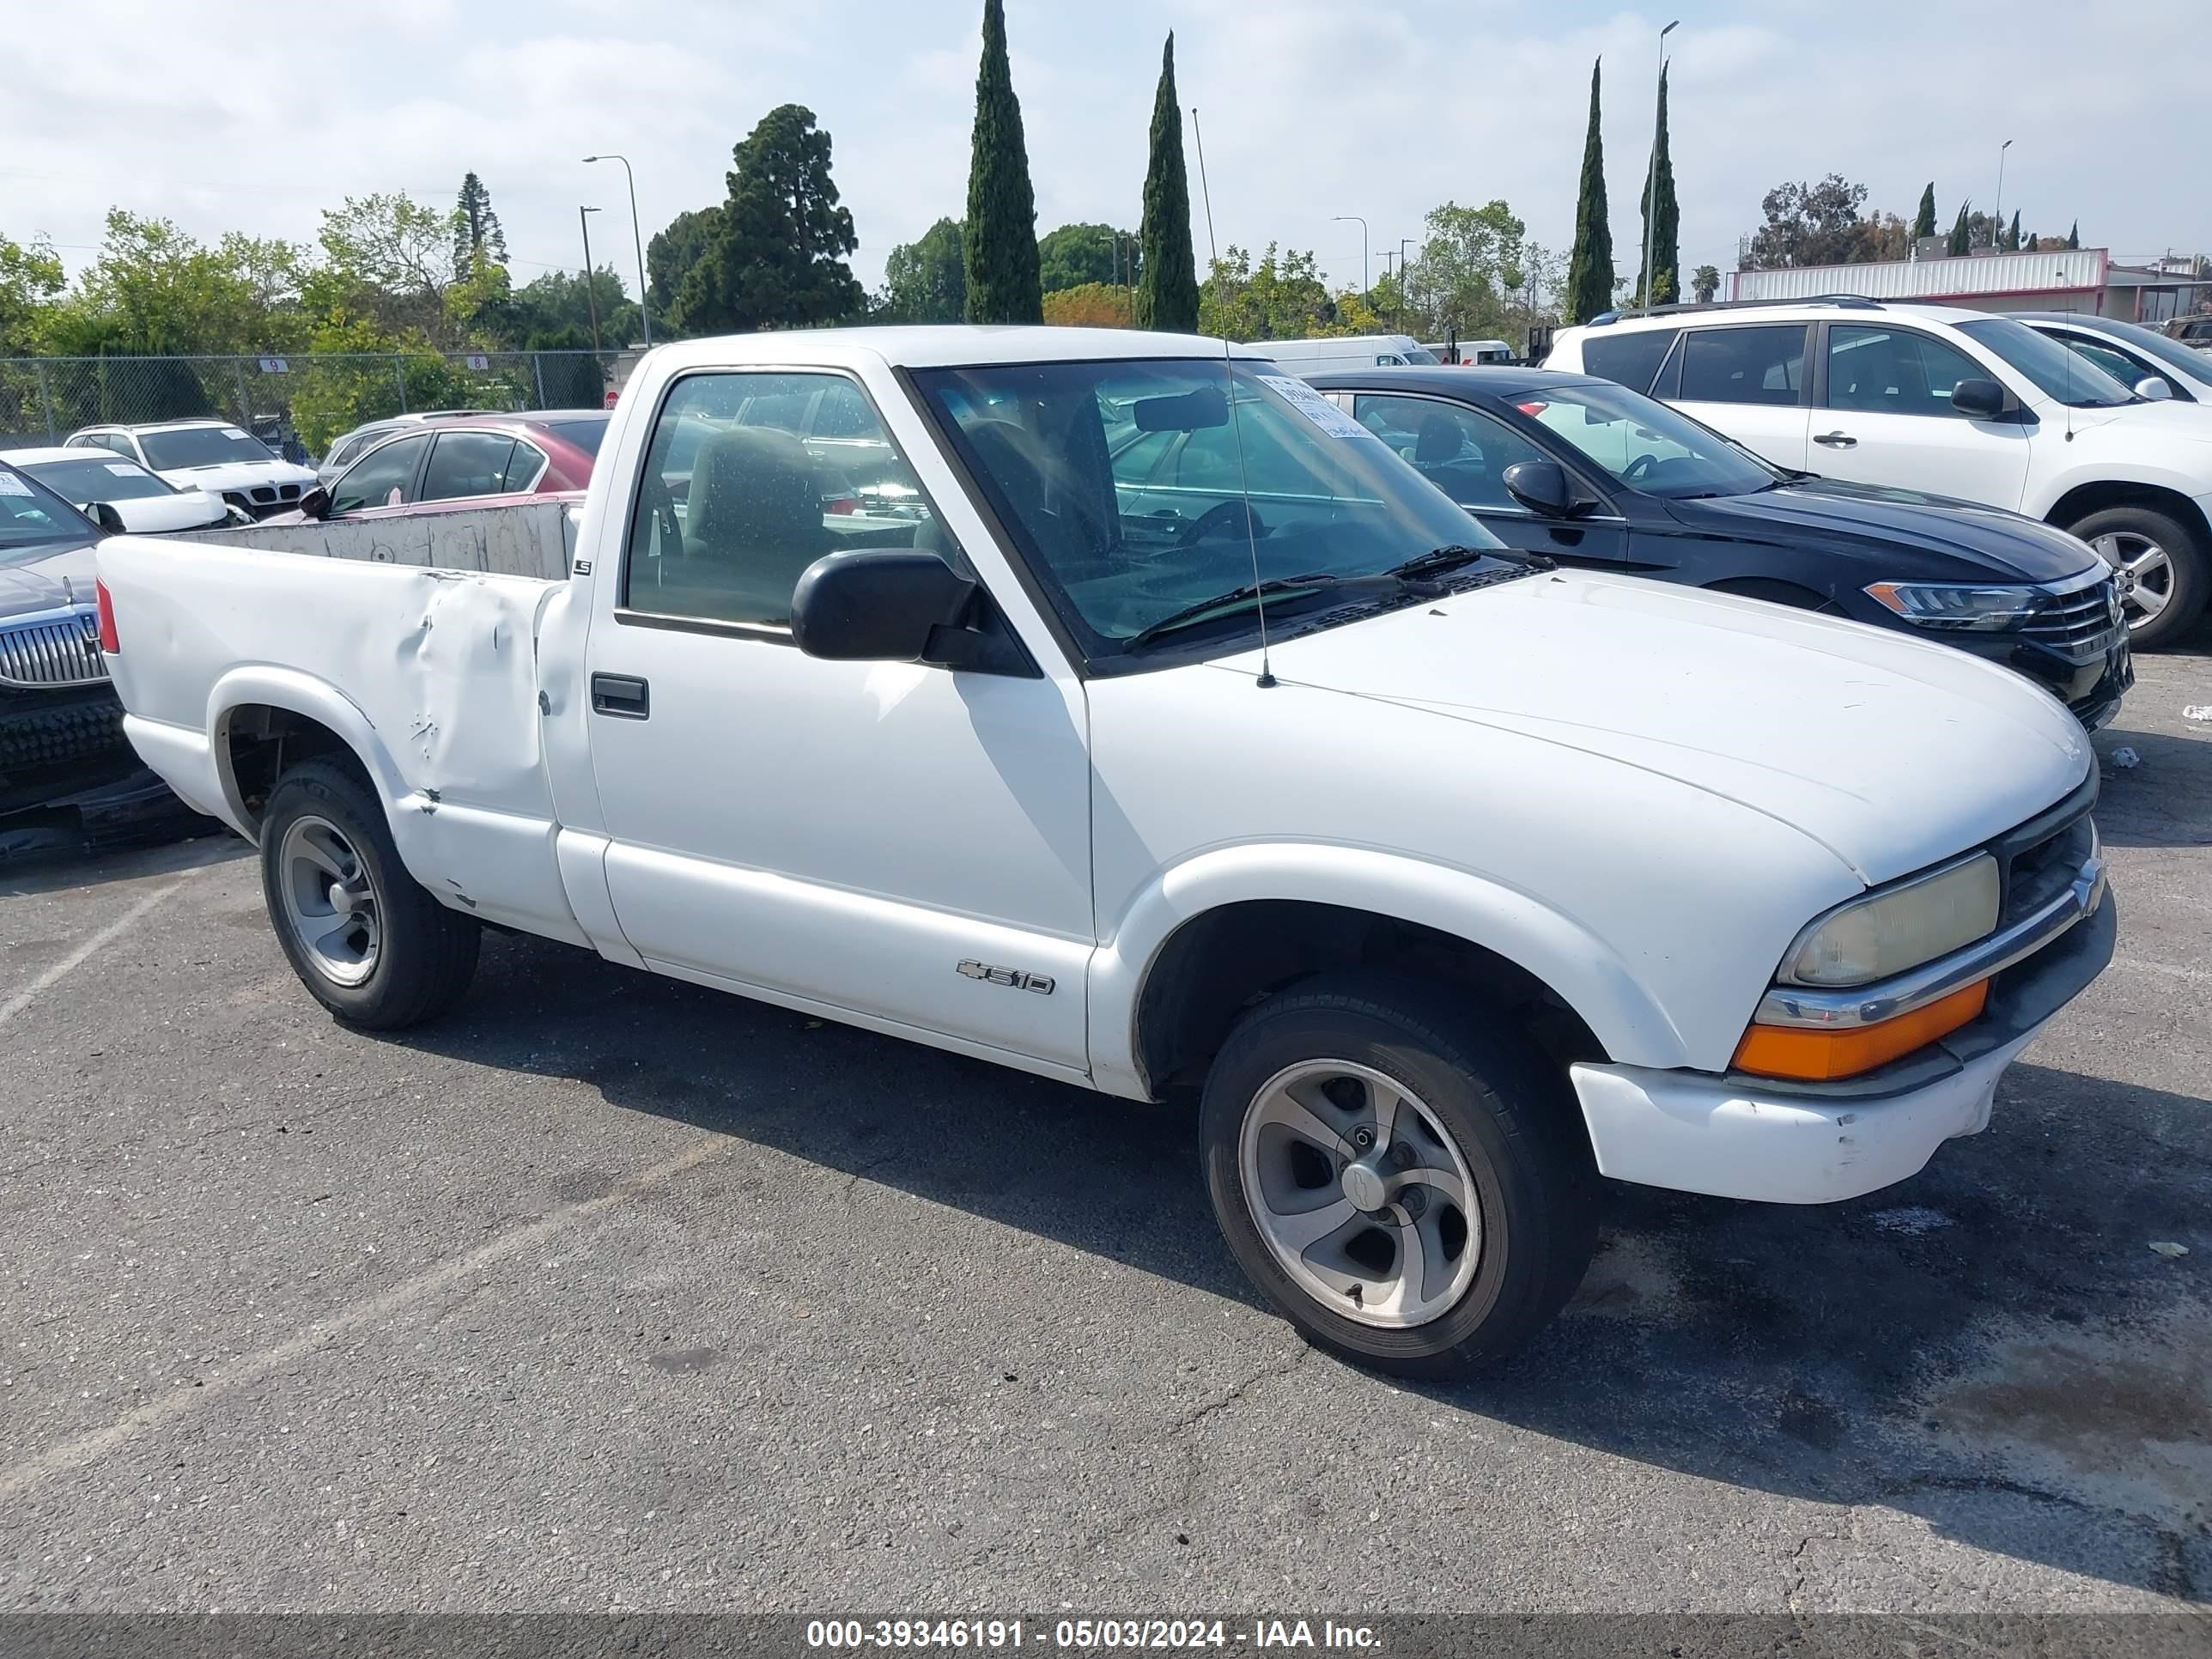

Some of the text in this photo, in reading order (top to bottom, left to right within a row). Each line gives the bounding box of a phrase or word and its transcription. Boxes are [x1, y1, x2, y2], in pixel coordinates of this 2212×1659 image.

[270, 359, 279, 372] 9
[474, 357, 482, 369] 8
[606, 398, 619, 410] STO
[574, 561, 590, 574] LS
[988, 963, 1056, 995] S10
